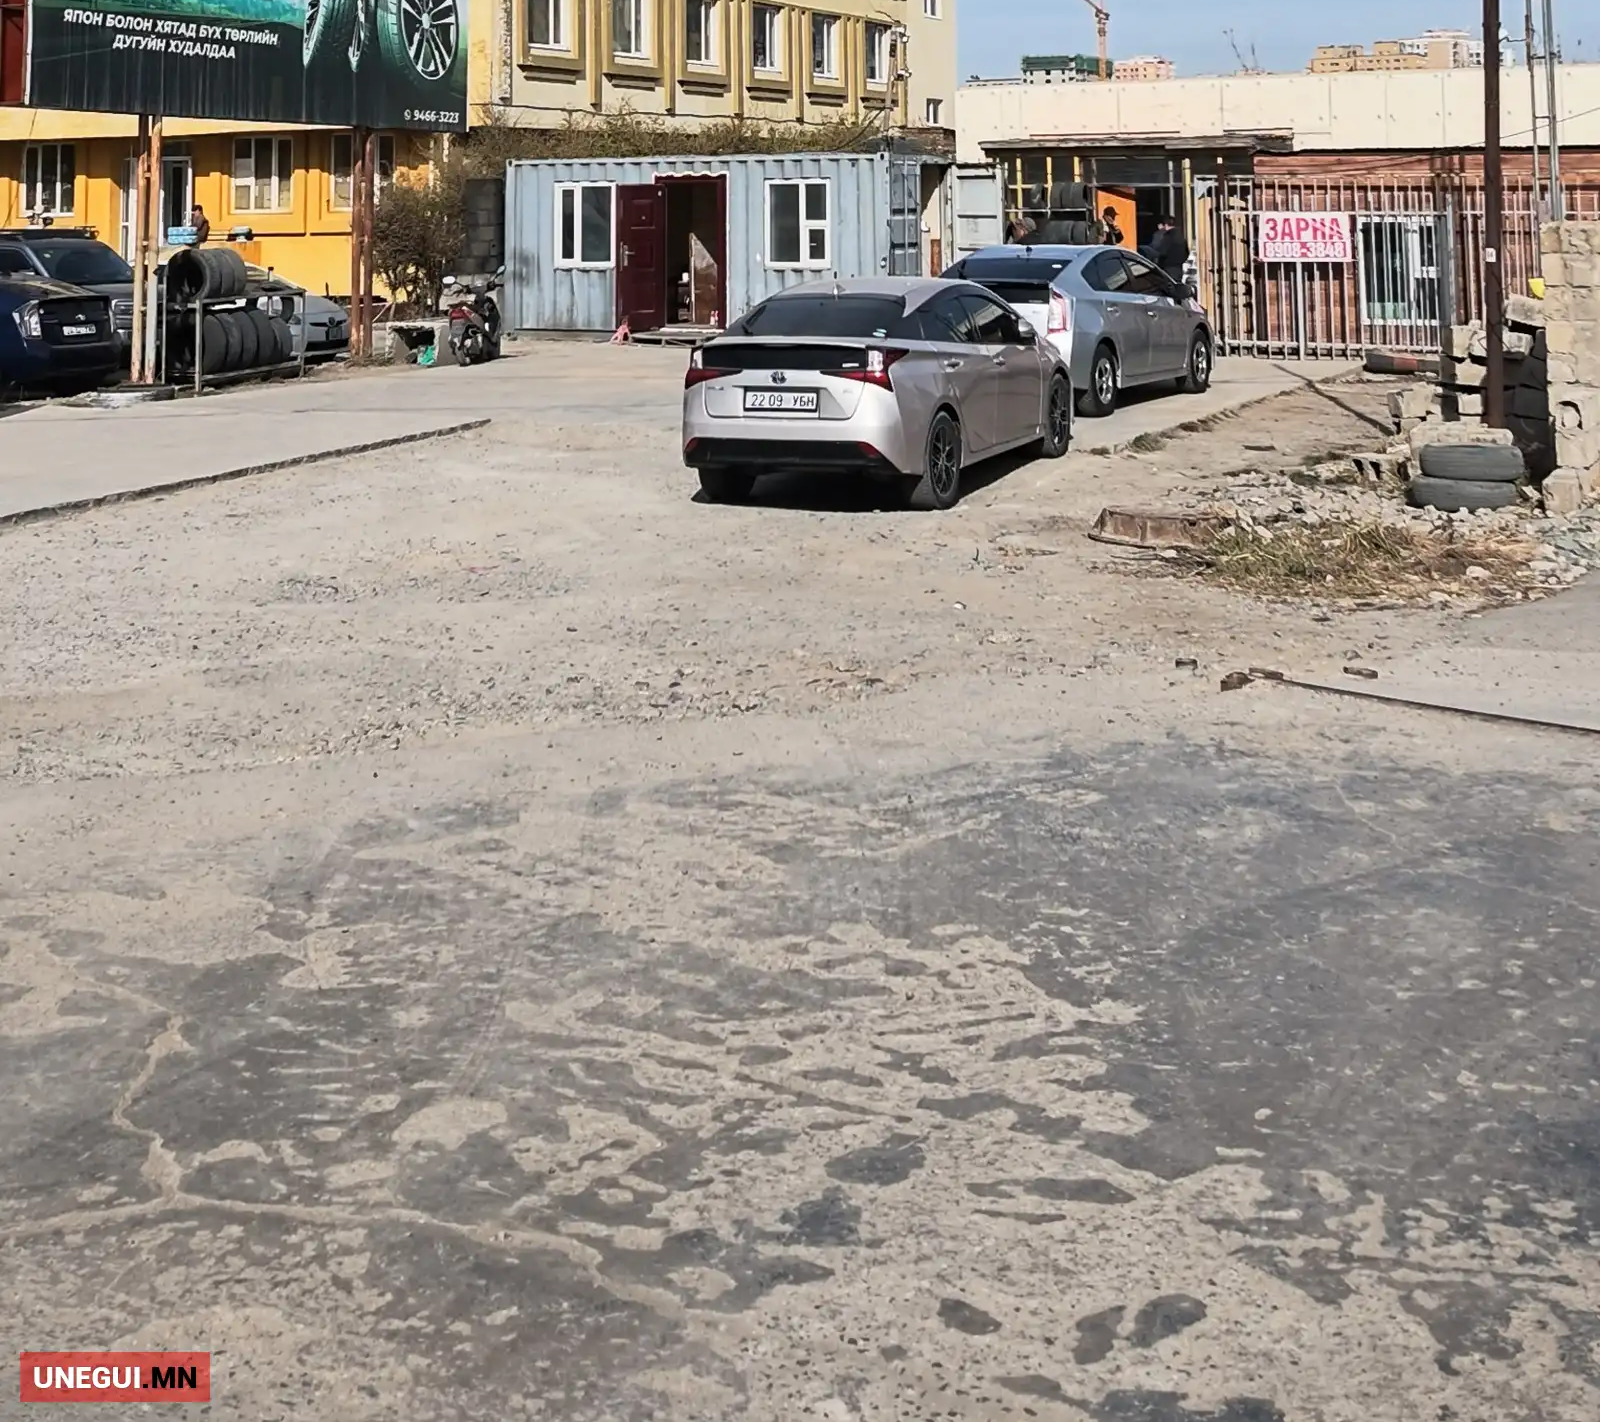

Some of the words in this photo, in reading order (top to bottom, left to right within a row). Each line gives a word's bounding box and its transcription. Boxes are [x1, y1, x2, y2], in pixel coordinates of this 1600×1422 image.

[63, 8, 102, 26] ЯПОН
[106, 13, 153, 32] БОЛОН
[155, 19, 196, 39] ХЯТАД
[199, 24, 222, 40] БҮХ
[224, 27, 279, 46] ТӨРЛИЙН
[112, 33, 166, 52] ДУГУЙН
[168, 38, 236, 59] ХУДАЛДАА
[792, 395, 815, 407] УБН
